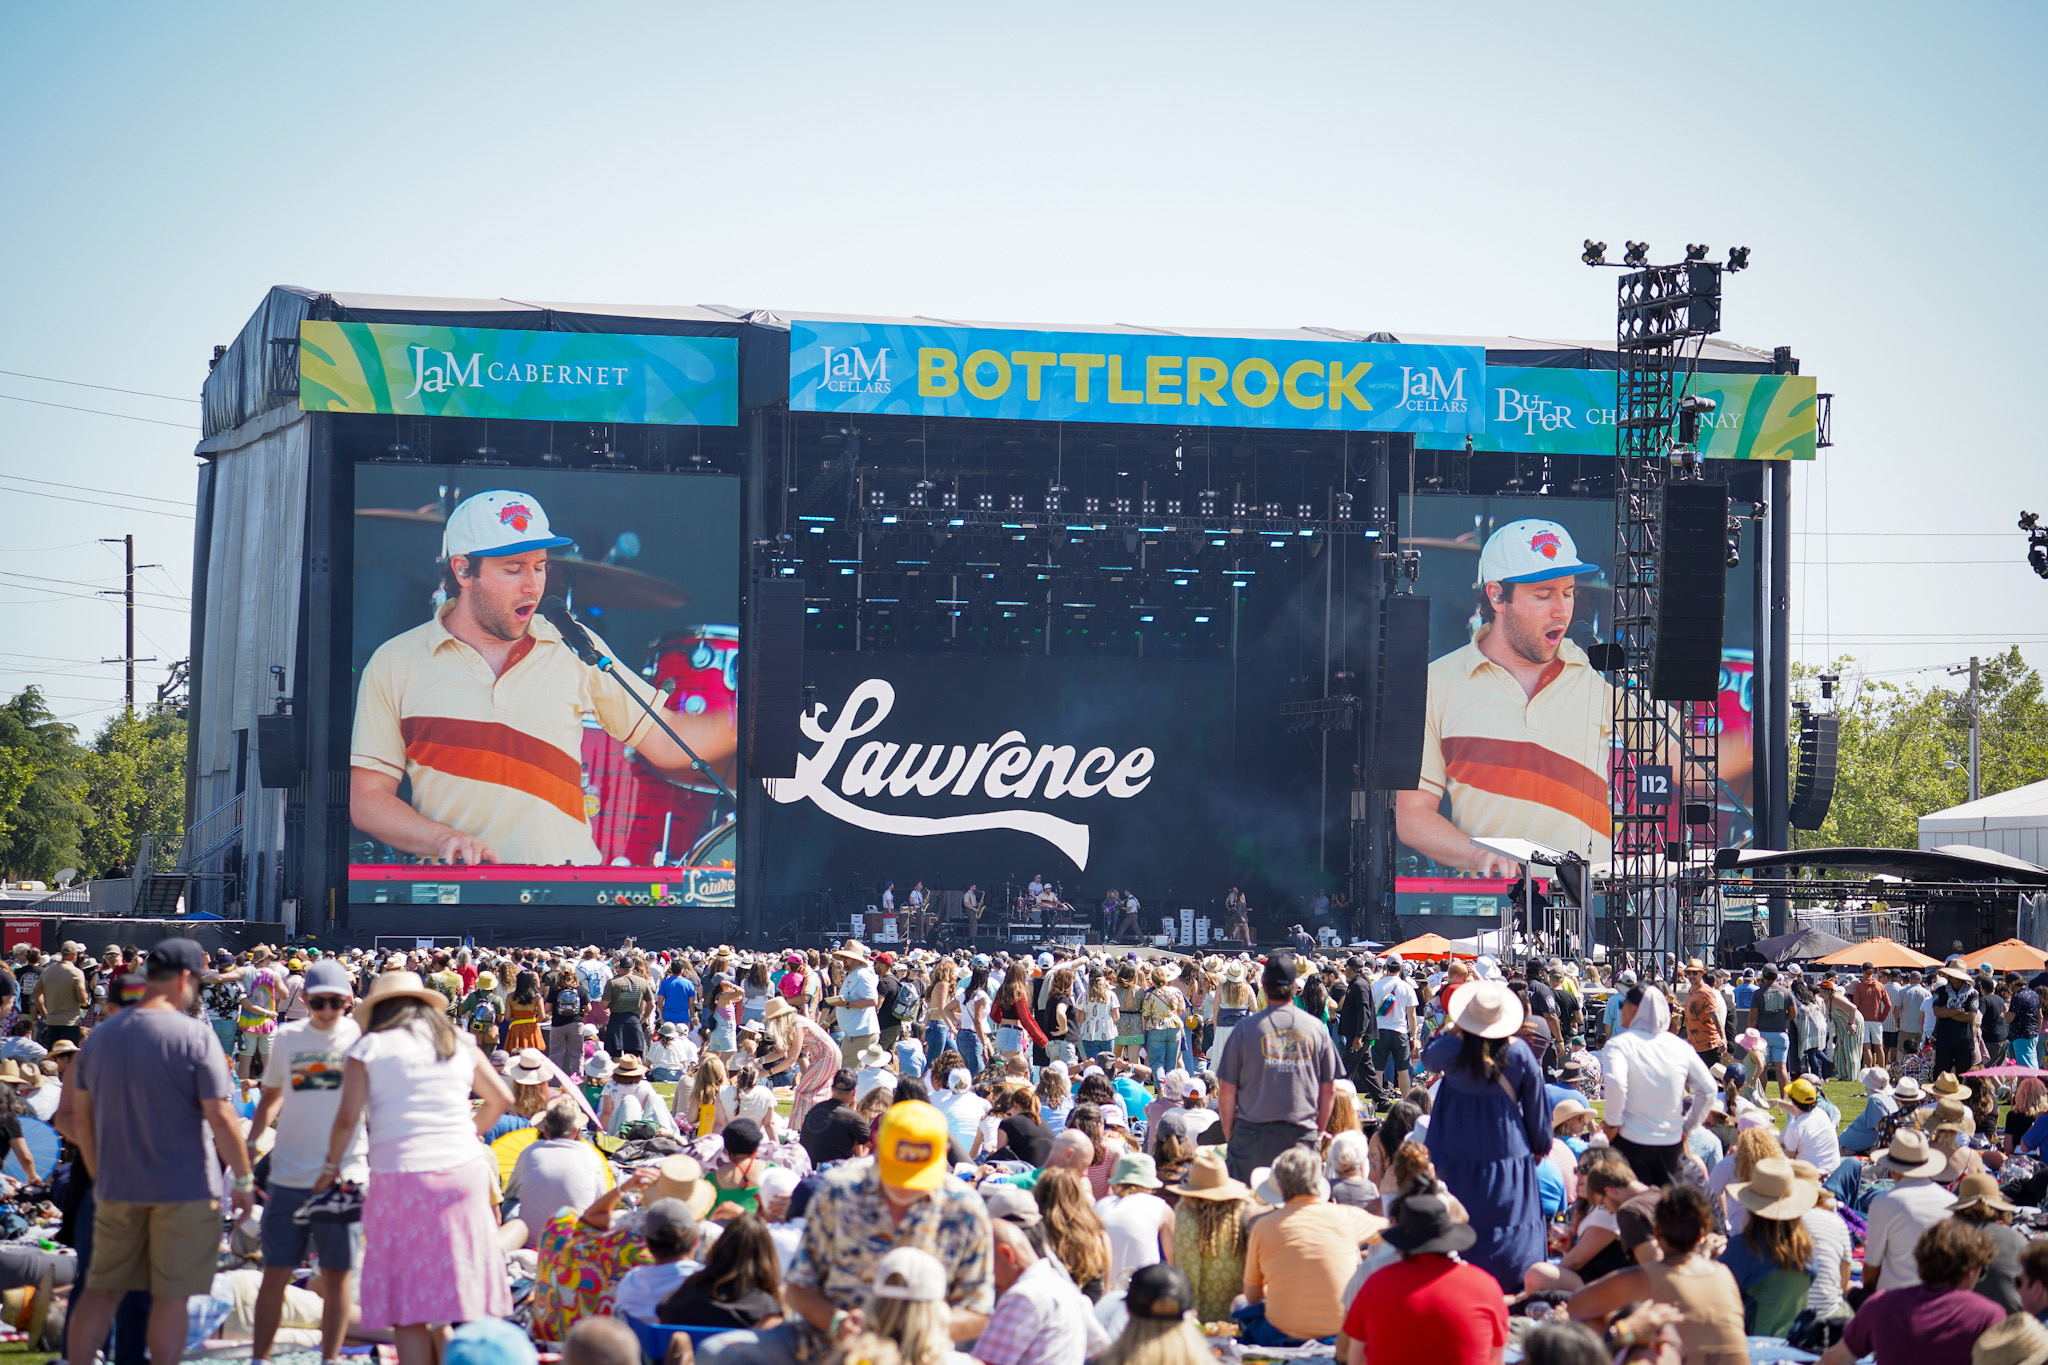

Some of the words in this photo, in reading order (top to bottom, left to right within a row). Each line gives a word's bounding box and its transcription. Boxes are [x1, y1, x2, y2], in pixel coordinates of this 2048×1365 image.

[488, 362, 628, 386] CABERNET
[918, 347, 1373, 411] BOTTLEROCK
[828, 380, 891, 394] CELLARS
[1406, 400, 1468, 413] CELLARS
[1585, 409, 1742, 429] CHAONAY
[762, 678, 1155, 871] Lawrence
[1642, 775, 1668, 793] 112
